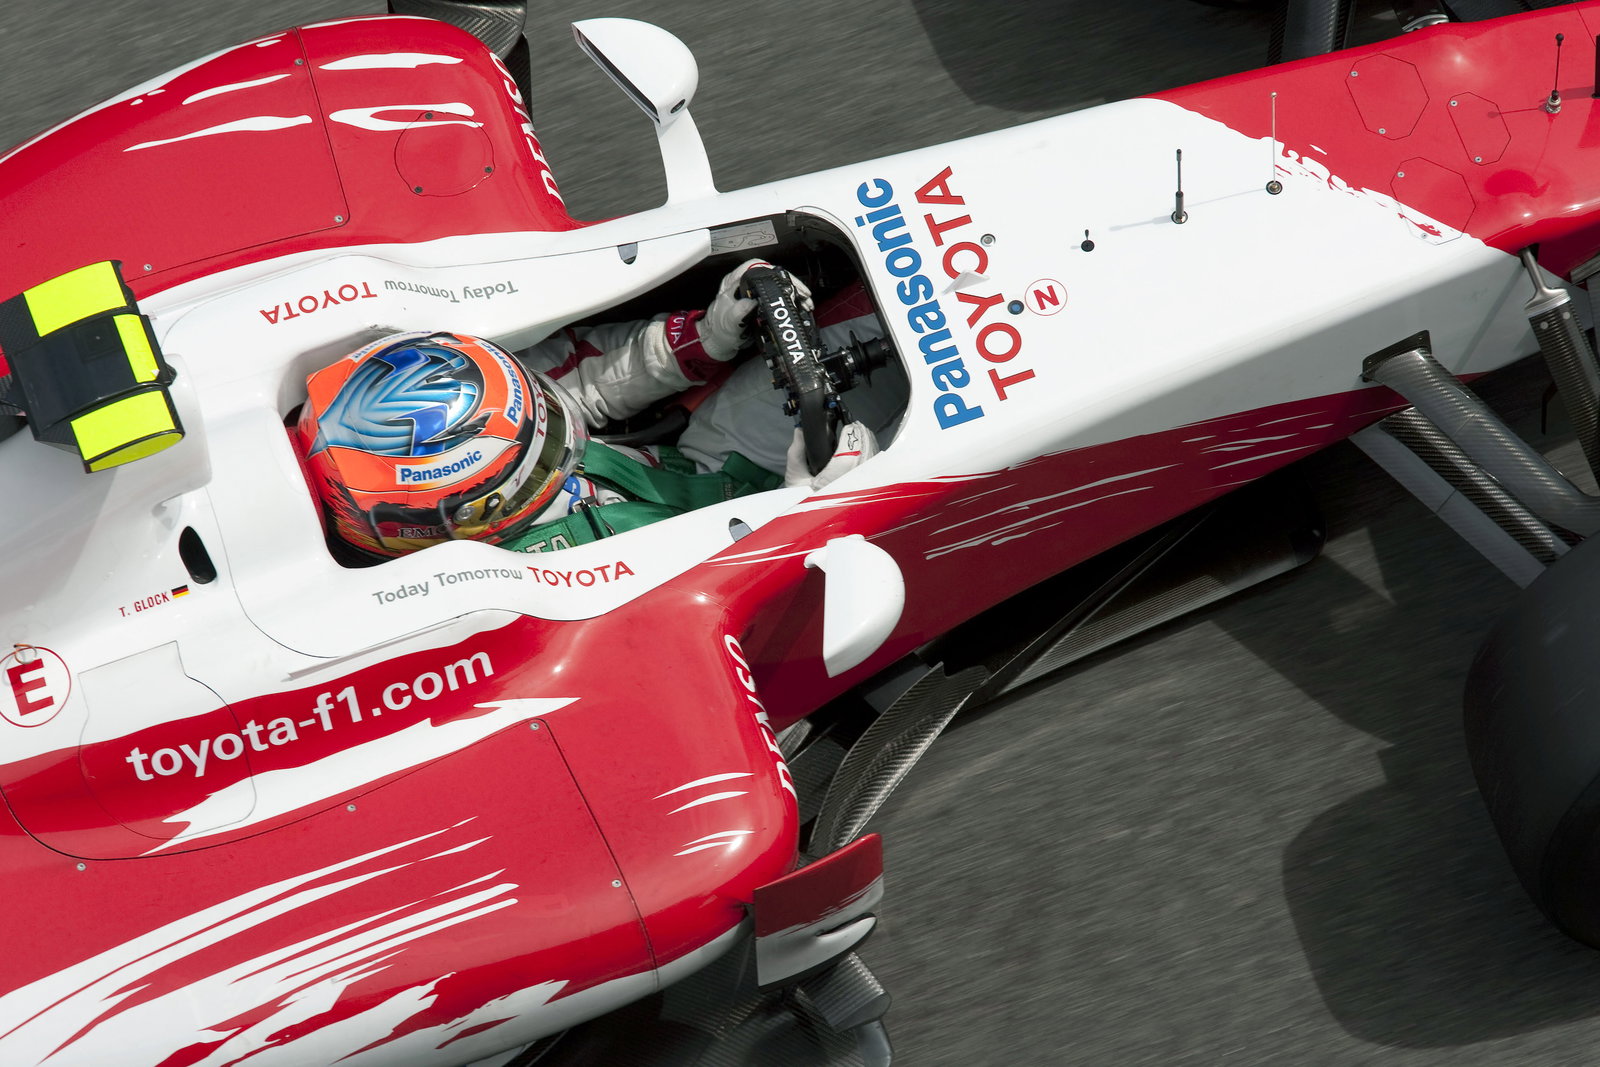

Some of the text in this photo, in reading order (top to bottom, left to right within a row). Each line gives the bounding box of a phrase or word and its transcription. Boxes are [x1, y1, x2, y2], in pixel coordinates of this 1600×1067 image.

[259, 280, 519, 325] Today Tomorrow TOYOTA
[854, 178, 985, 431] Panasonic
[914, 165, 1036, 401] TOYOTA
[1033, 285, 1060, 311] N
[769, 296, 805, 365] TOYOTA
[481, 342, 522, 424] Panasonic
[400, 450, 482, 482] Panasonic
[118, 591, 170, 617] T. GLOCK
[372, 560, 635, 605] Today Tomorrow TOYOTA
[6, 658, 55, 717] E
[125, 651, 495, 782] toyota-f1.com
